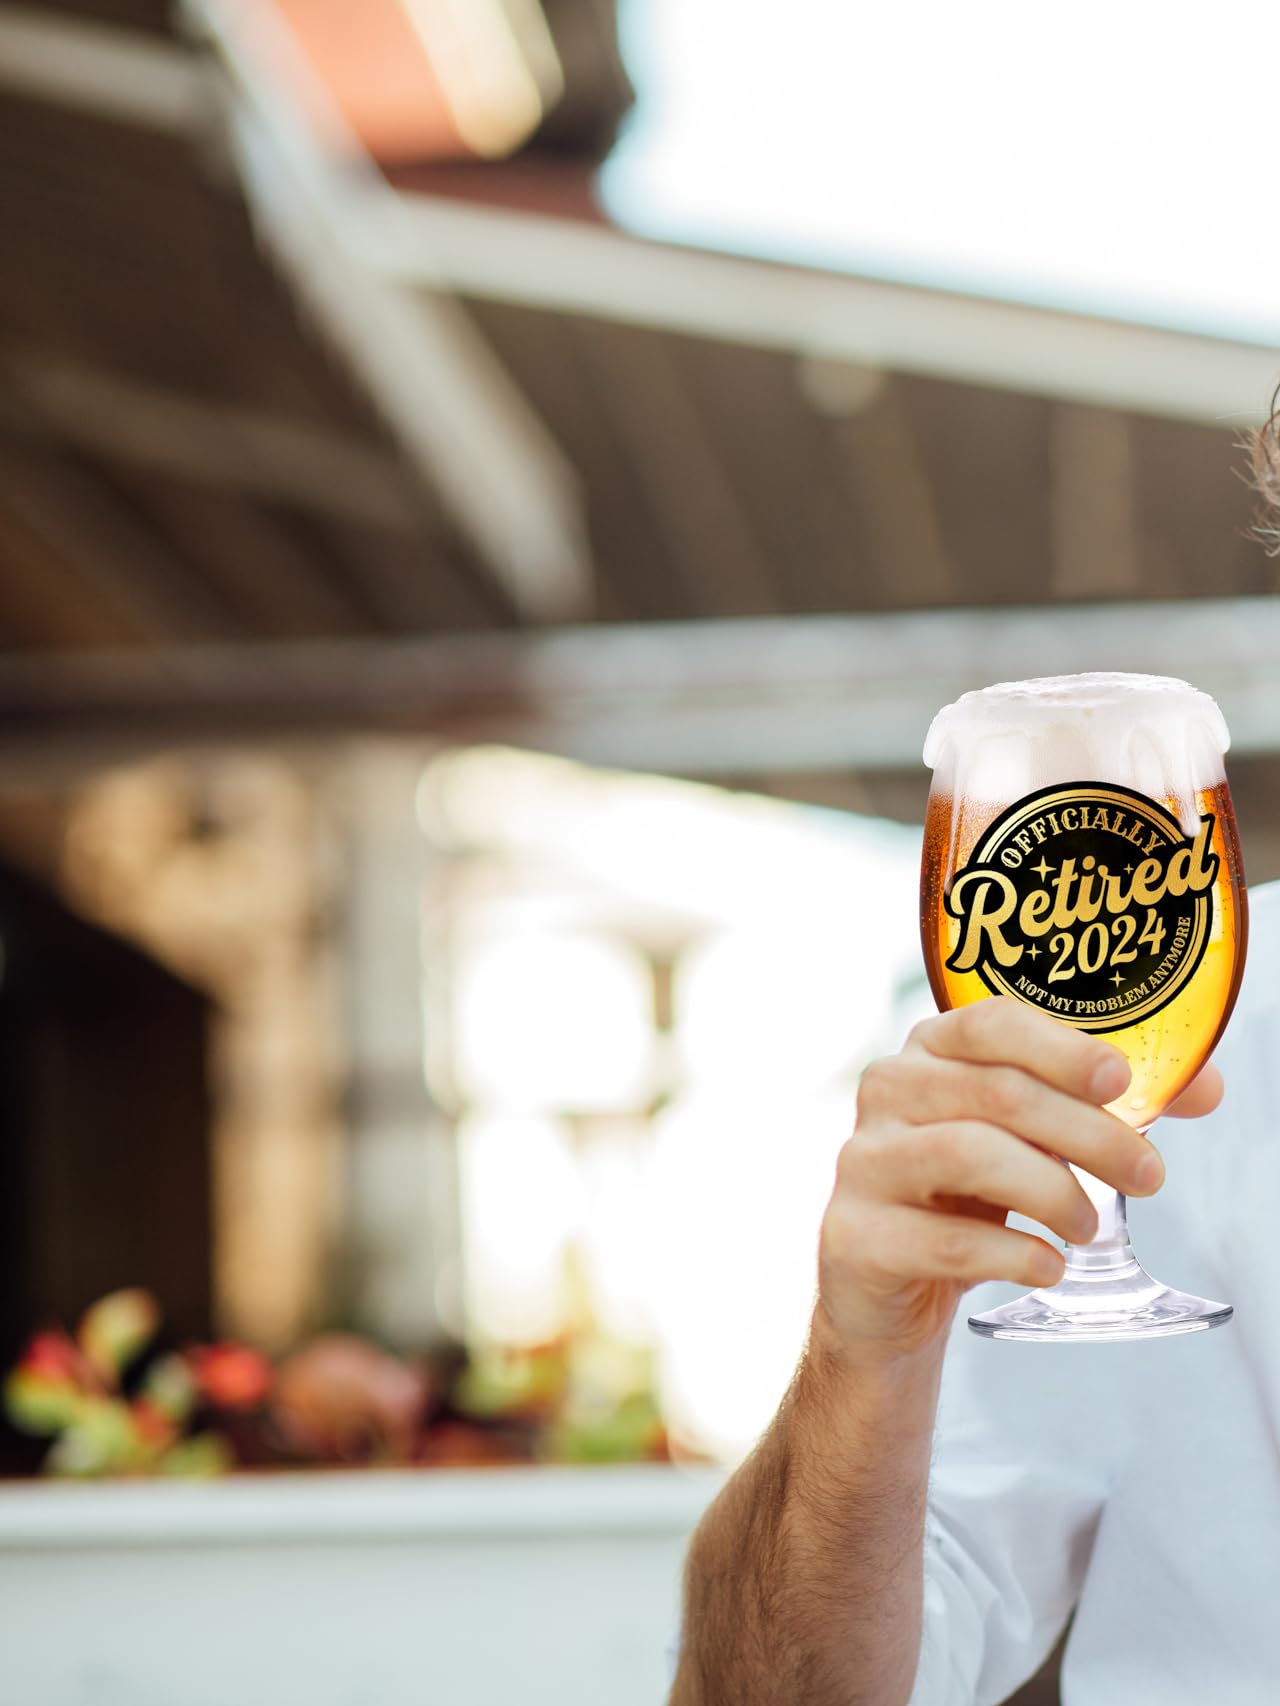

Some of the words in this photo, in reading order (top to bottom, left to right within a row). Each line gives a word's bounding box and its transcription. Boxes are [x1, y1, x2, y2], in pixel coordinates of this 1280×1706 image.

[1000, 807, 1167, 869] OFFICIALLY
[950, 814, 1215, 970] Retired
[1015, 975, 1048, 1002] NOT
[1048, 997, 1072, 1013] MY
[1075, 986, 1150, 1014] PROBLEM
[1149, 916, 1191, 989] ANYMORE
[1048, 908, 1167, 985] 2024
